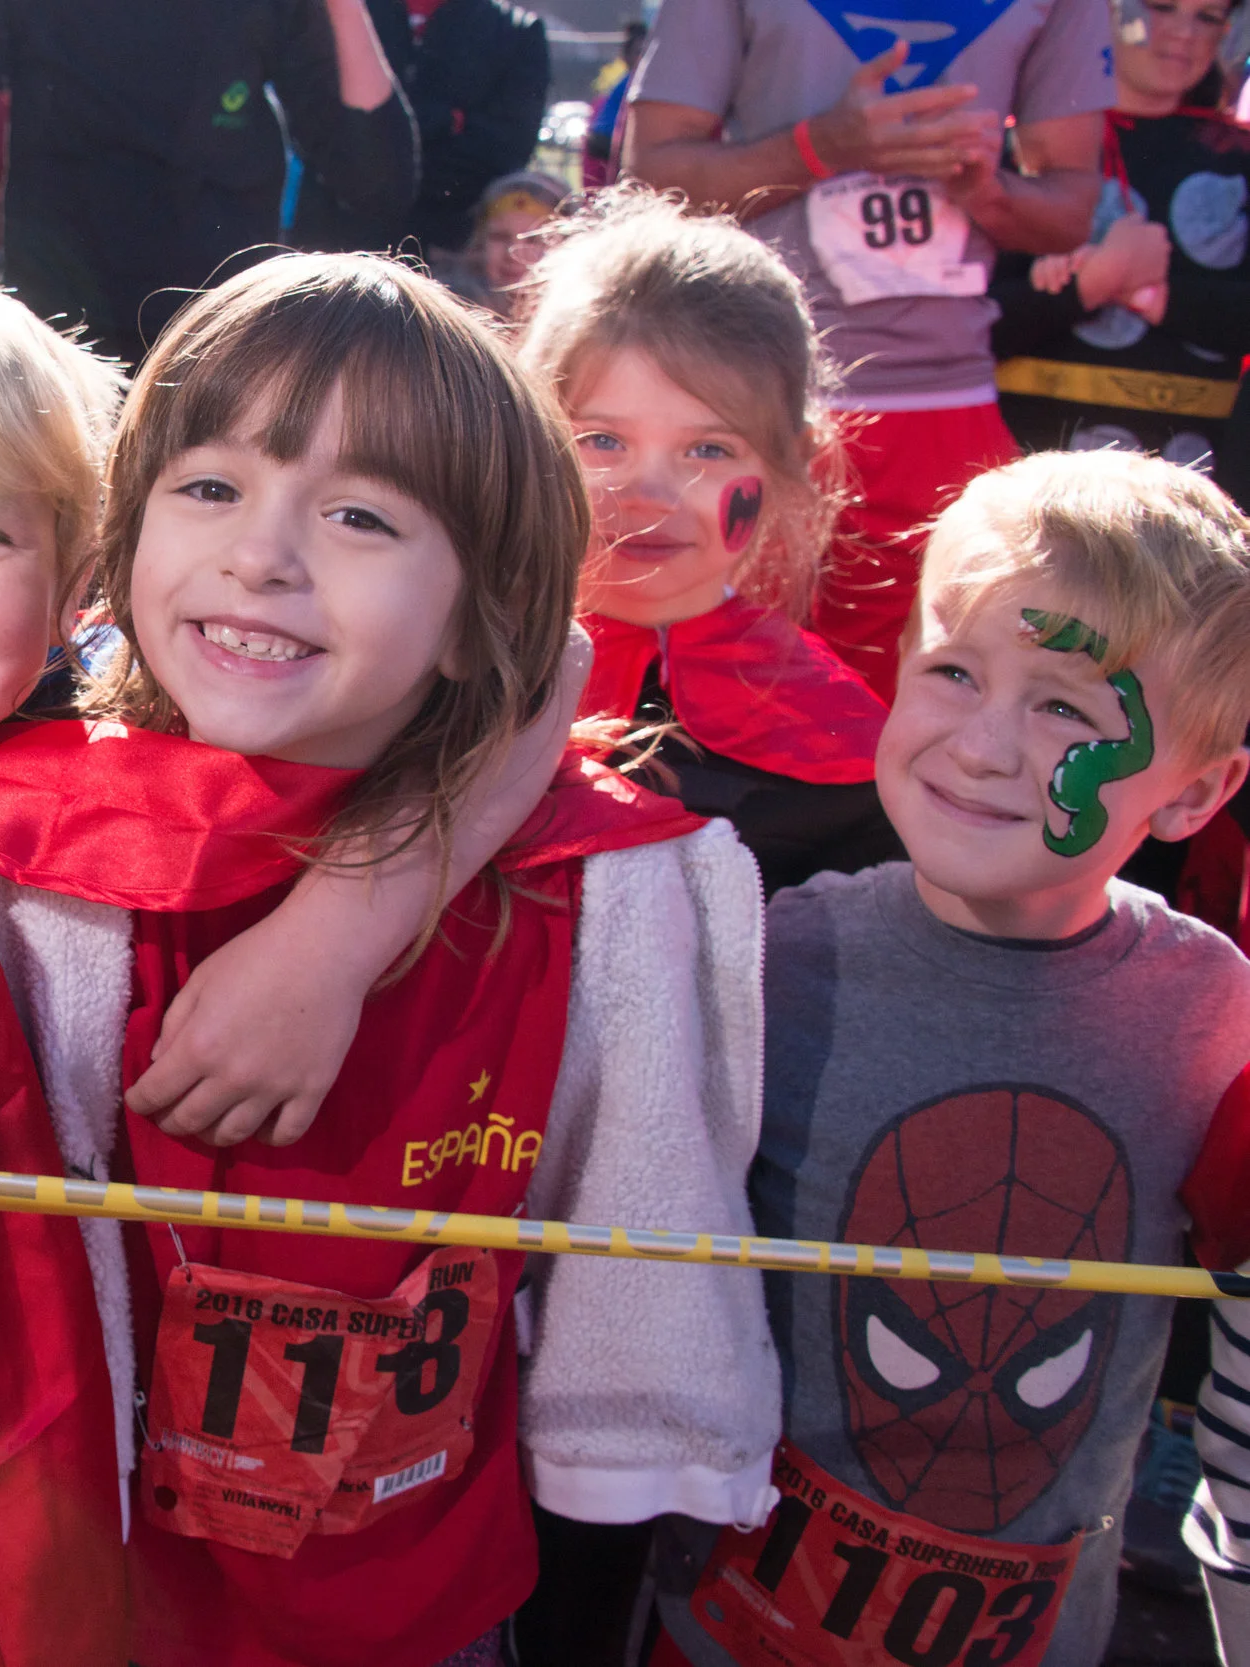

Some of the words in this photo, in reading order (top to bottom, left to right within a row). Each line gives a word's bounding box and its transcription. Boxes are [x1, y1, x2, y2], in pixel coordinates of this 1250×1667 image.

[861, 187, 934, 249] 99
[401, 1112, 543, 1187] ESPAÑA
[194, 1288, 264, 1321] 2016
[270, 1302, 338, 1332] CASA
[429, 1261, 475, 1293] RUN
[775, 1456, 828, 1510] 2016
[830, 1501, 890, 1549] CASA
[894, 1534, 1030, 1581] SUPERHERO
[752, 1494, 1058, 1667] 1103
